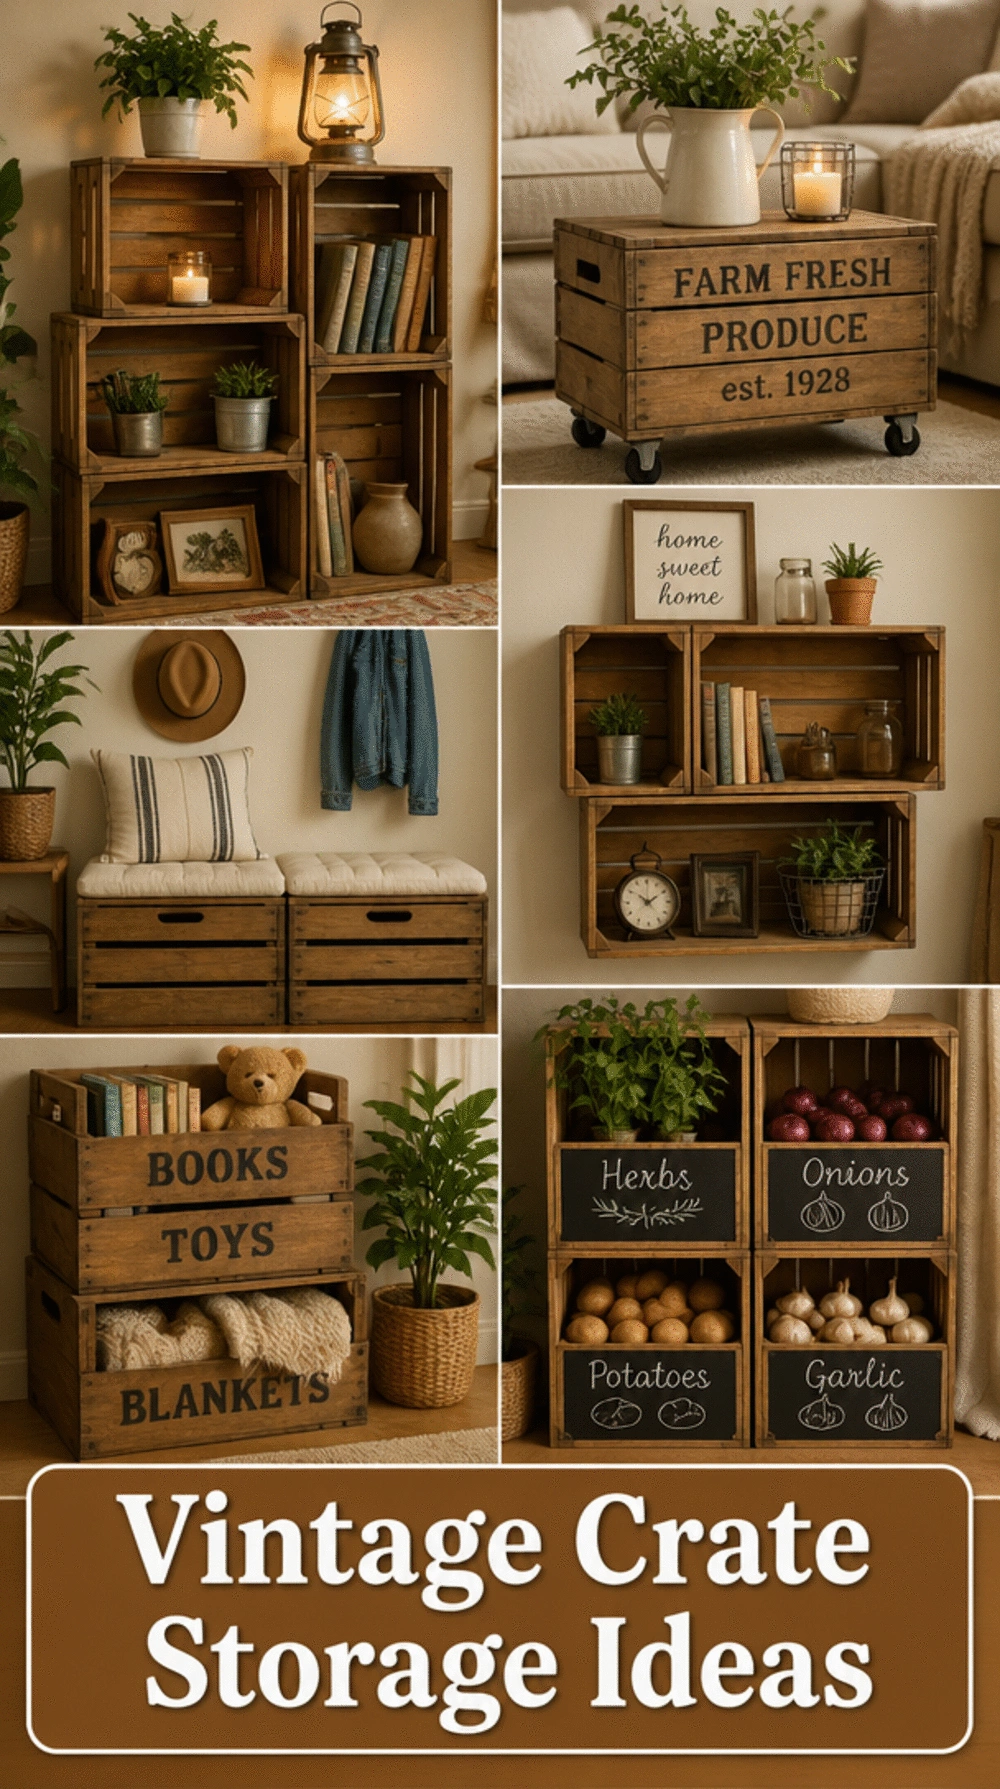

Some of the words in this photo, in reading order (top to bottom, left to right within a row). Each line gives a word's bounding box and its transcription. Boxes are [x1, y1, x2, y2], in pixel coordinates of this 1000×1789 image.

[673, 263, 771, 298] FARM
[785, 257, 891, 291] FRESH
[701, 312, 868, 354] PRODUCE
[721, 373, 772, 402] est.
[785, 366, 850, 397] 1928
[655, 523, 723, 549] home
[656, 556, 722, 579] sweet
[658, 582, 724, 606] home
[147, 1145, 289, 1187] BOOKS
[602, 1158, 693, 1191] Herbs
[802, 1157, 910, 1188] Onions
[161, 1221, 275, 1263] TOYS
[588, 1359, 711, 1390] Potatoes
[805, 1357, 904, 1393] Garlic
[120, 1372, 330, 1426] BLANKETS
